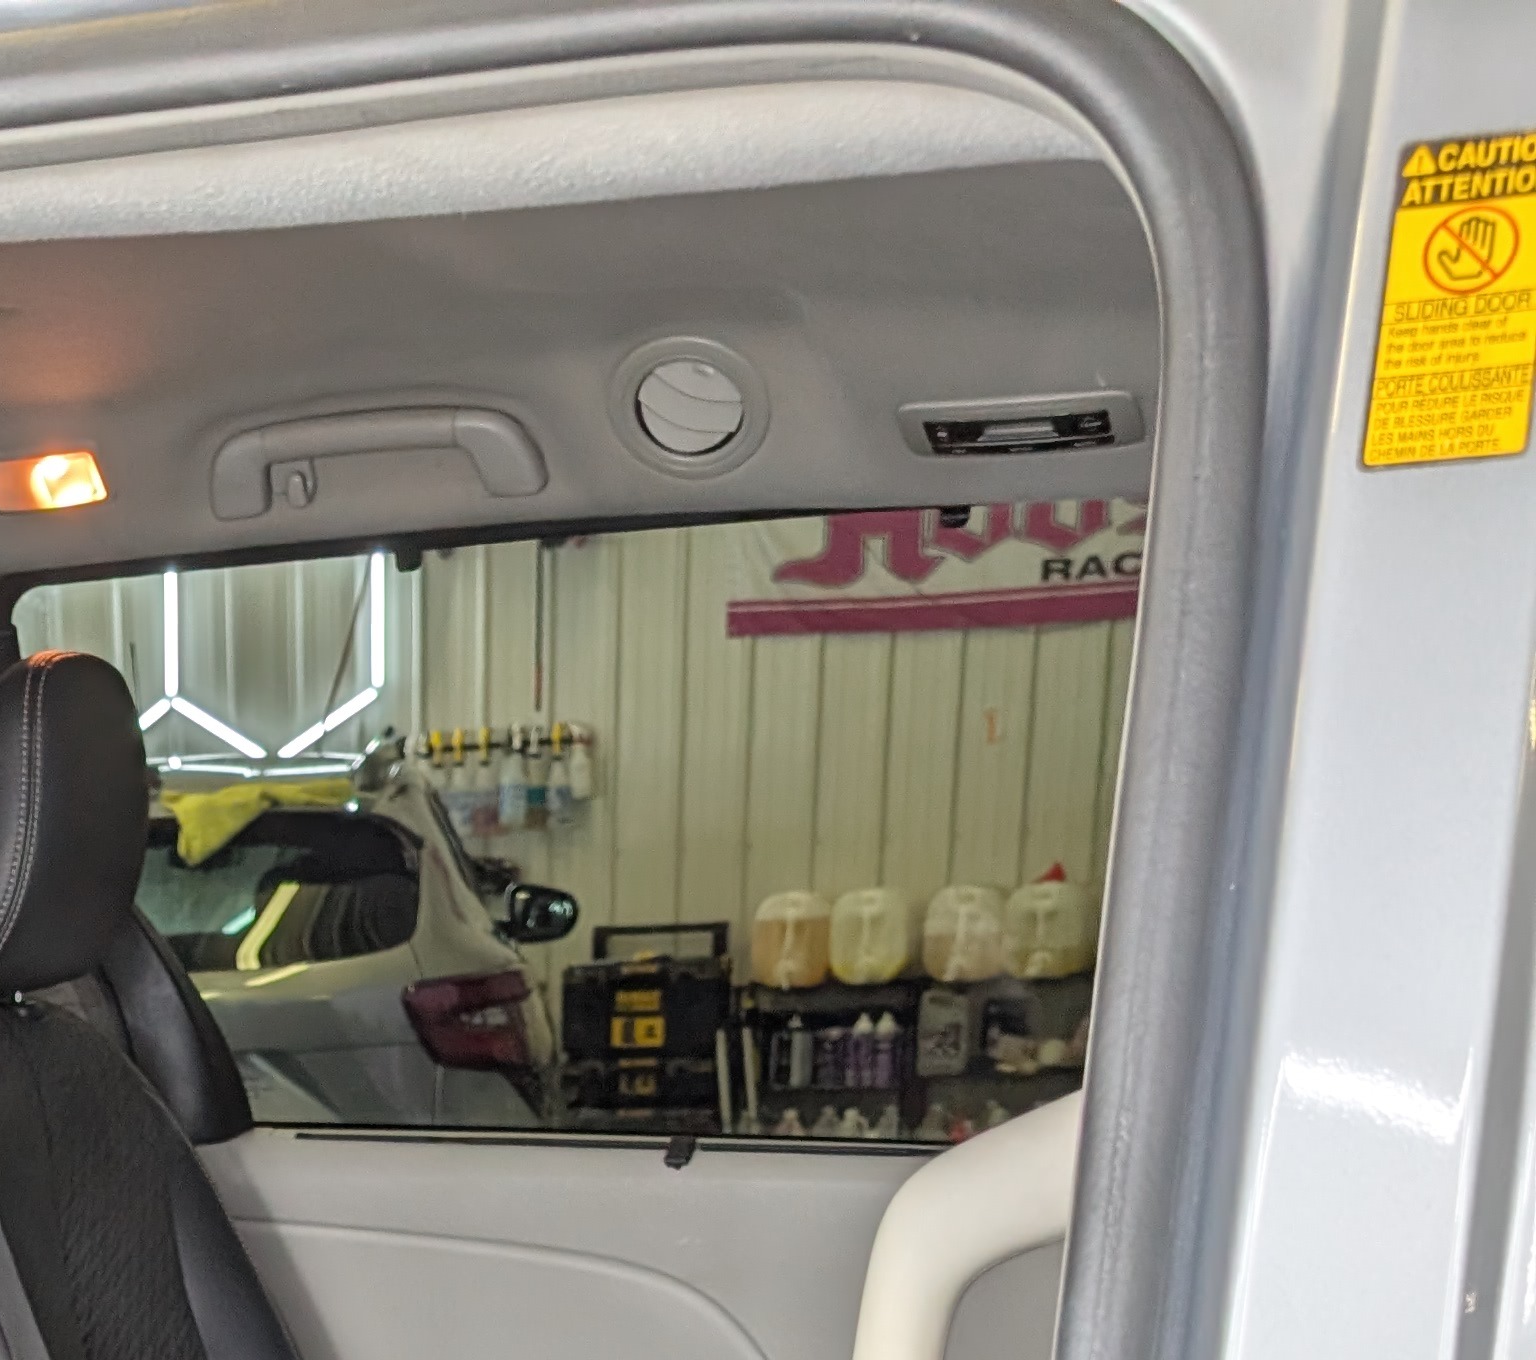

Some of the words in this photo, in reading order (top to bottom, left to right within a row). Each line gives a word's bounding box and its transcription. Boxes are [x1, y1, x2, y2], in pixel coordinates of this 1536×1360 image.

[1394, 297, 1468, 322] SLIDING
[1474, 291, 1531, 314] DOOR
[1422, 322, 1458, 334] hands
[1465, 318, 1491, 329] clear
[1496, 315, 1508, 327] of
[1386, 342, 1405, 354] the
[1409, 340, 1434, 351] door
[1440, 338, 1464, 348] area
[1485, 331, 1527, 343] reduce
[1384, 359, 1401, 370] the
[1406, 355, 1426, 367] risk
[1431, 354, 1442, 365] of
[1376, 376, 1425, 397] PORTE
[1428, 366, 1529, 392] COULISSANTE
[1376, 400, 1408, 415] POUR
[1465, 394, 1477, 404] LE
[1480, 389, 1524, 403] RISQUE
[1374, 418, 1389, 430] DE
[1394, 412, 1457, 428] BLESSURE
[1463, 406, 1512, 419] GARDER
[1372, 433, 1393, 446] LES
[1398, 429, 1435, 443] MAINS
[1439, 426, 1473, 439] HORS
[1477, 424, 1495, 436] DU
[1370, 447, 1416, 461] CHEMIN
[1420, 445, 1436, 456] DE
[1440, 443, 1456, 454] LA
